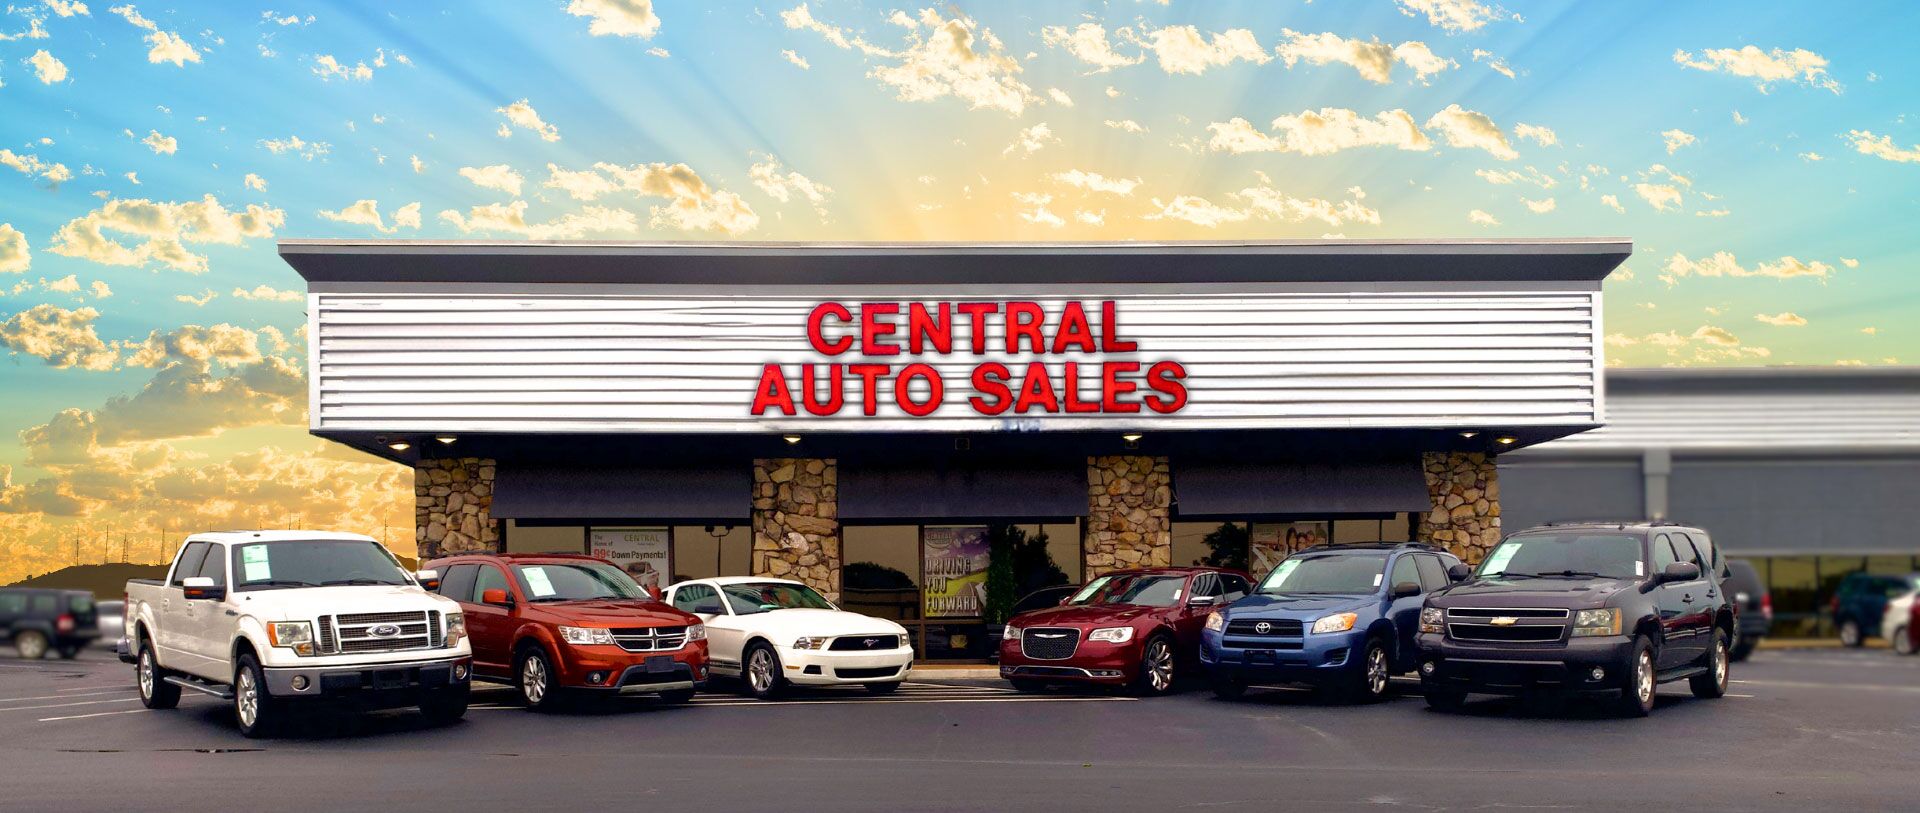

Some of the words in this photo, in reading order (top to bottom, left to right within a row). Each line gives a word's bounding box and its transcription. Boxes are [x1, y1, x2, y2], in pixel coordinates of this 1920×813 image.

[807, 301, 1138, 356] CENTRAL
[750, 362, 944, 416] AUTO
[969, 361, 1188, 415] SALES
[624, 534, 660, 542] CENTRAL
[632, 551, 667, 560] Payments!
[926, 556, 971, 575] DRIVING
[925, 577, 947, 594] YOU
[925, 595, 978, 613] FORWARD
